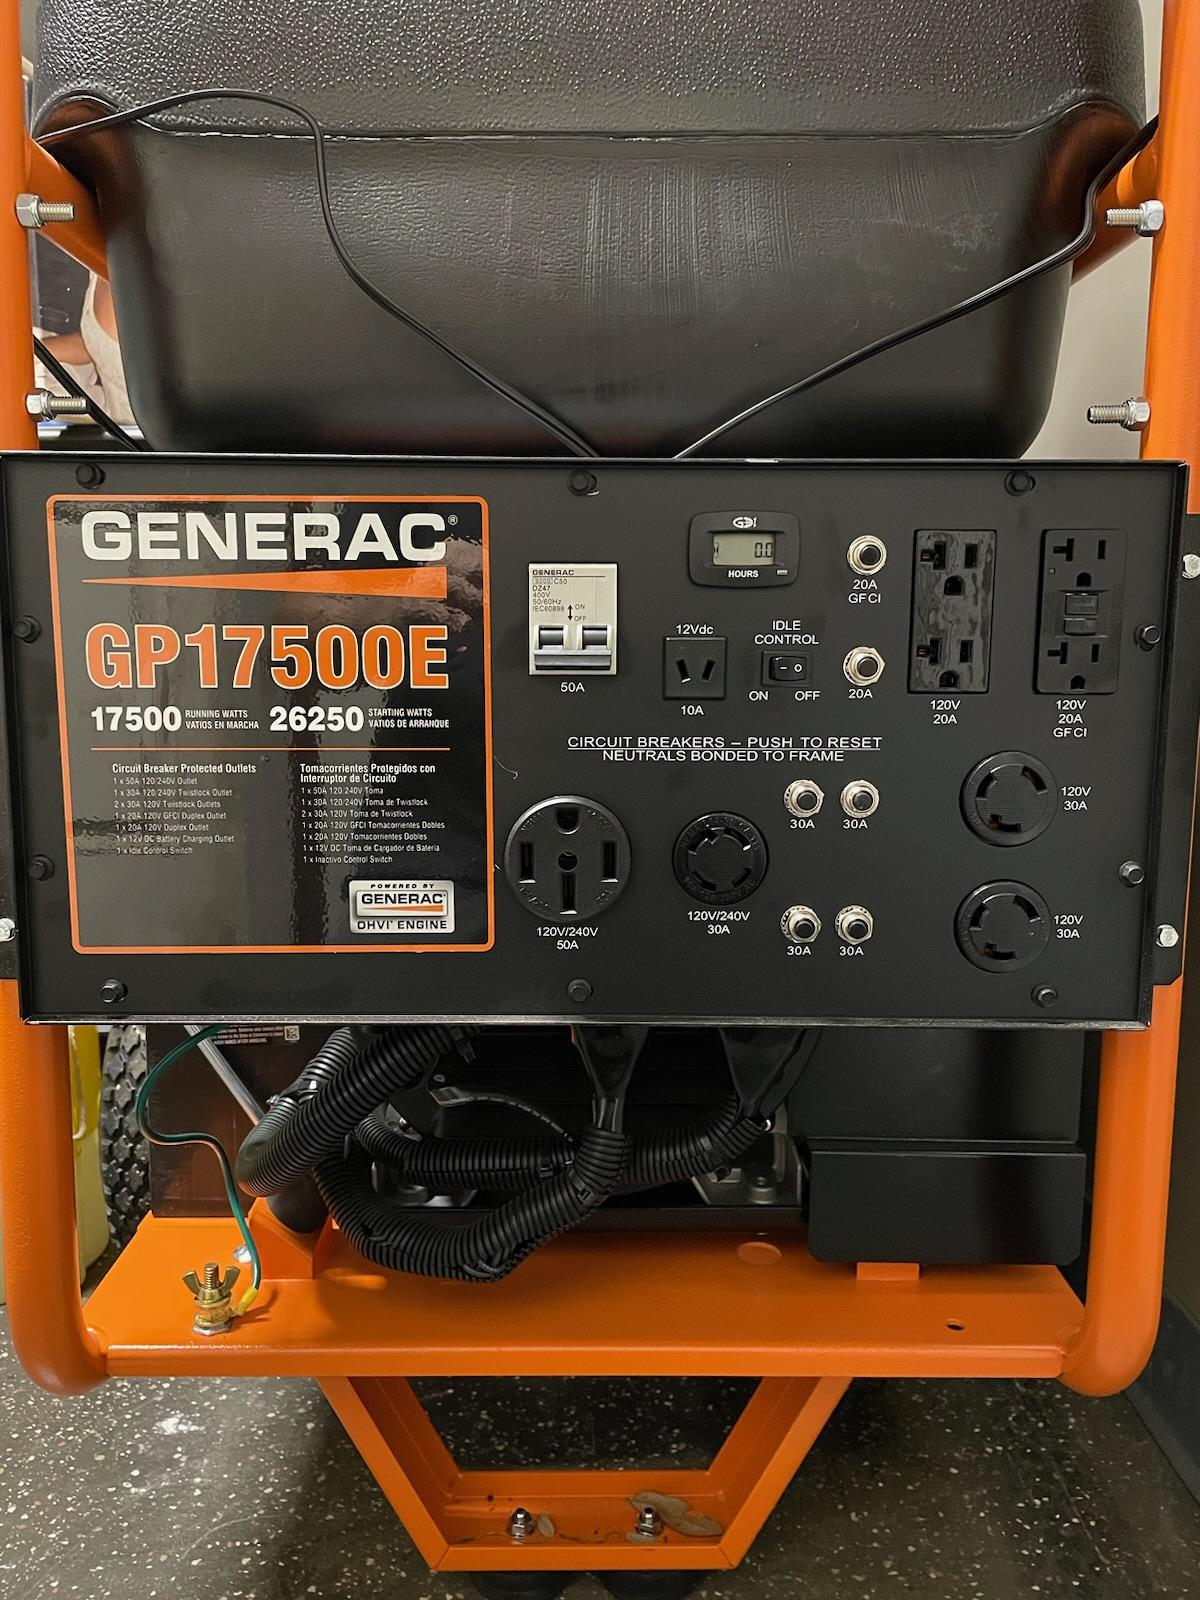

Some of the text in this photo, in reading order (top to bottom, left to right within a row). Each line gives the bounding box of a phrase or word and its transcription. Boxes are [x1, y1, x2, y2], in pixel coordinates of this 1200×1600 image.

[852, 579, 878, 590] 20A
[676, 624, 714, 634] 12Vdc
[772, 620, 801, 631] IDLE
[754, 634, 819, 645] CONTROL
[85, 624, 449, 689] GP17500E
[560, 682, 585, 692] 50A
[748, 690, 769, 701] ON
[794, 690, 821, 701] OFF
[848, 689, 873, 699] 20A
[930, 700, 961, 710] 120V
[1056, 700, 1087, 710] 120V
[185, 710, 248, 718] RUNNING WATTS
[368, 708, 432, 717] STARTING WATTS
[681, 705, 704, 716] 10A
[91, 706, 182, 731] 17500
[269, 706, 364, 732] 26250
[368, 719, 449, 728] VATIOS DE ARRANQUE
[933, 714, 957, 724] 20A
[1058, 714, 1083, 724] 20A
[186, 721, 259, 729] VATIOS EN MARCHA
[567, 737, 882, 748] CIRCUIT BREAKERS PUSH TO RESET
[602, 750, 844, 762] NEUTRALS BONDED TO FRAME
[112, 764, 256, 773] Circuit Breaker Protected Outlets
[300, 763, 368, 773] Tomacorrientes
[371, 763, 417, 774] Protegidos
[300, 773, 397, 784] Interruptor de Circuito
[1061, 787, 1092, 797] 120V
[1063, 801, 1088, 811] 30A
[789, 819, 816, 830] 30A
[842, 819, 869, 830] 30A
[686, 911, 750, 921] 120V/240V
[1053, 915, 1083, 925] 120V
[398, 921, 447, 929] ENGINE
[707, 924, 731, 935] 30A
[536, 926, 599, 937] 120V/240V
[1056, 929, 1080, 939] 30A
[556, 940, 579, 950] 50A
[786, 946, 812, 956] 30A
[839, 946, 864, 956] 30A
